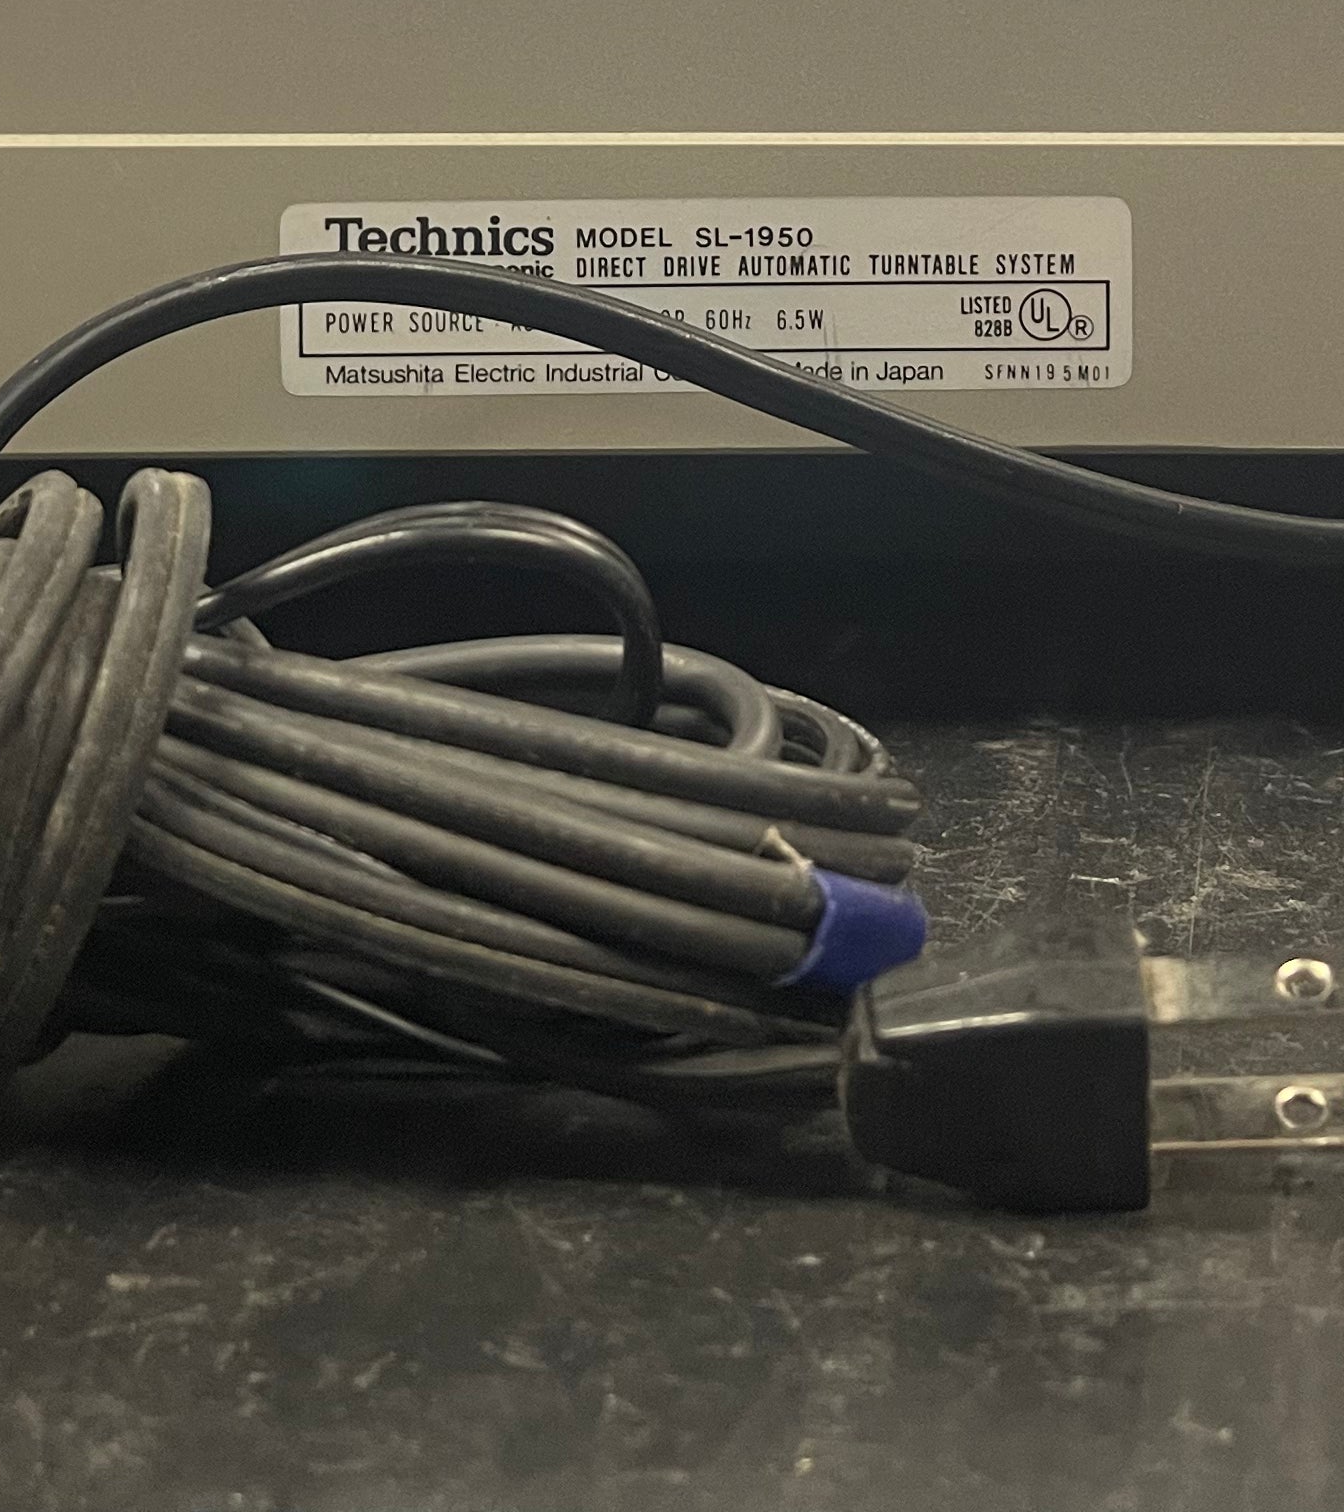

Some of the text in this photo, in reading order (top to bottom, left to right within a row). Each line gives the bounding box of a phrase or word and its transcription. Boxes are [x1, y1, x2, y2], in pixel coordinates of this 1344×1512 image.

[325, 216, 554, 256] Technics
[576, 226, 813, 249] MODEL SL-1950
[576, 253, 1075, 278] DIRECT DRIVE AUTOMATIC TURNTABLE SYSTEM
[960, 296, 1012, 315] LISTED
[326, 312, 394, 334] POWER
[409, 311, 485, 333] SOURCE
[705, 309, 752, 331] 60Hz
[777, 309, 824, 331] 6.5W
[974, 319, 1013, 338] 828B
[326, 364, 445, 385] Matsushita
[455, 363, 536, 384] Electric
[546, 362, 643, 383] Industrial
[851, 361, 869, 381] in
[875, 361, 944, 385] Japan
